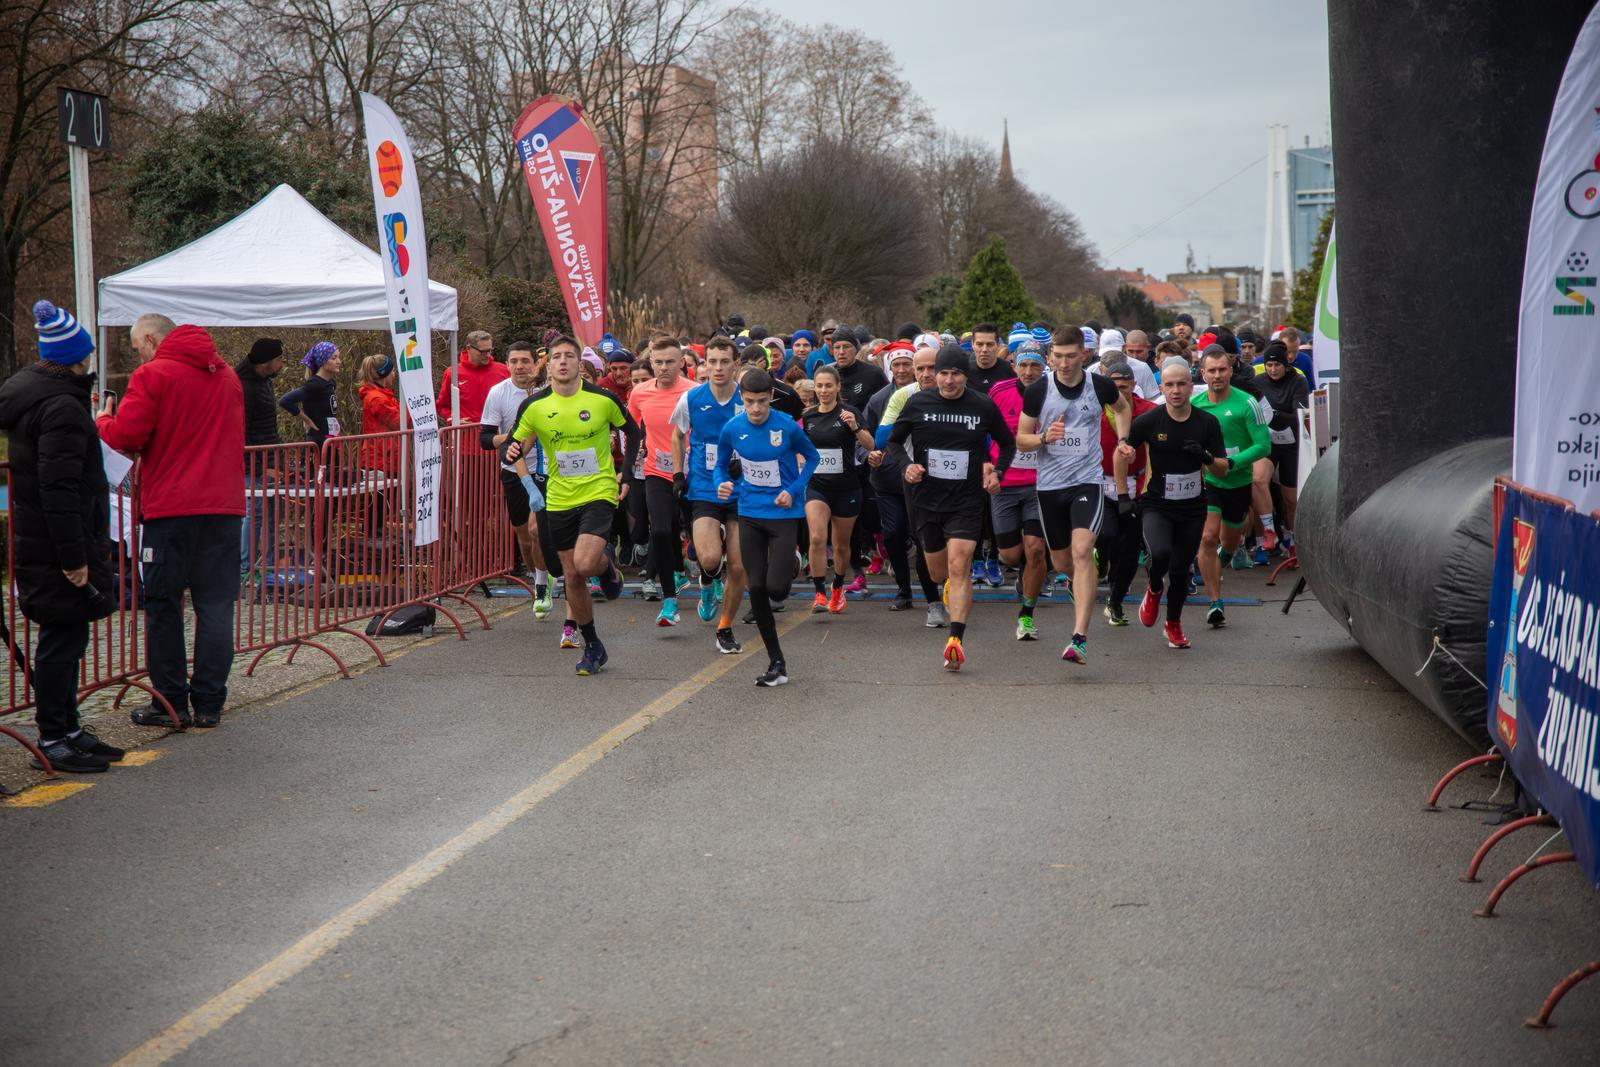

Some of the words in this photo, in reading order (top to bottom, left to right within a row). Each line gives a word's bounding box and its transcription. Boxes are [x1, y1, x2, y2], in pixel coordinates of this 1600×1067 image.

[1060, 438, 1081, 447] 308
[819, 457, 837, 466] 390
[1019, 453, 1037, 462] 291
[572, 460, 586, 469] 57
[943, 460, 957, 470] 95
[750, 469, 771, 479] 239
[1179, 481, 1196, 491] 149
